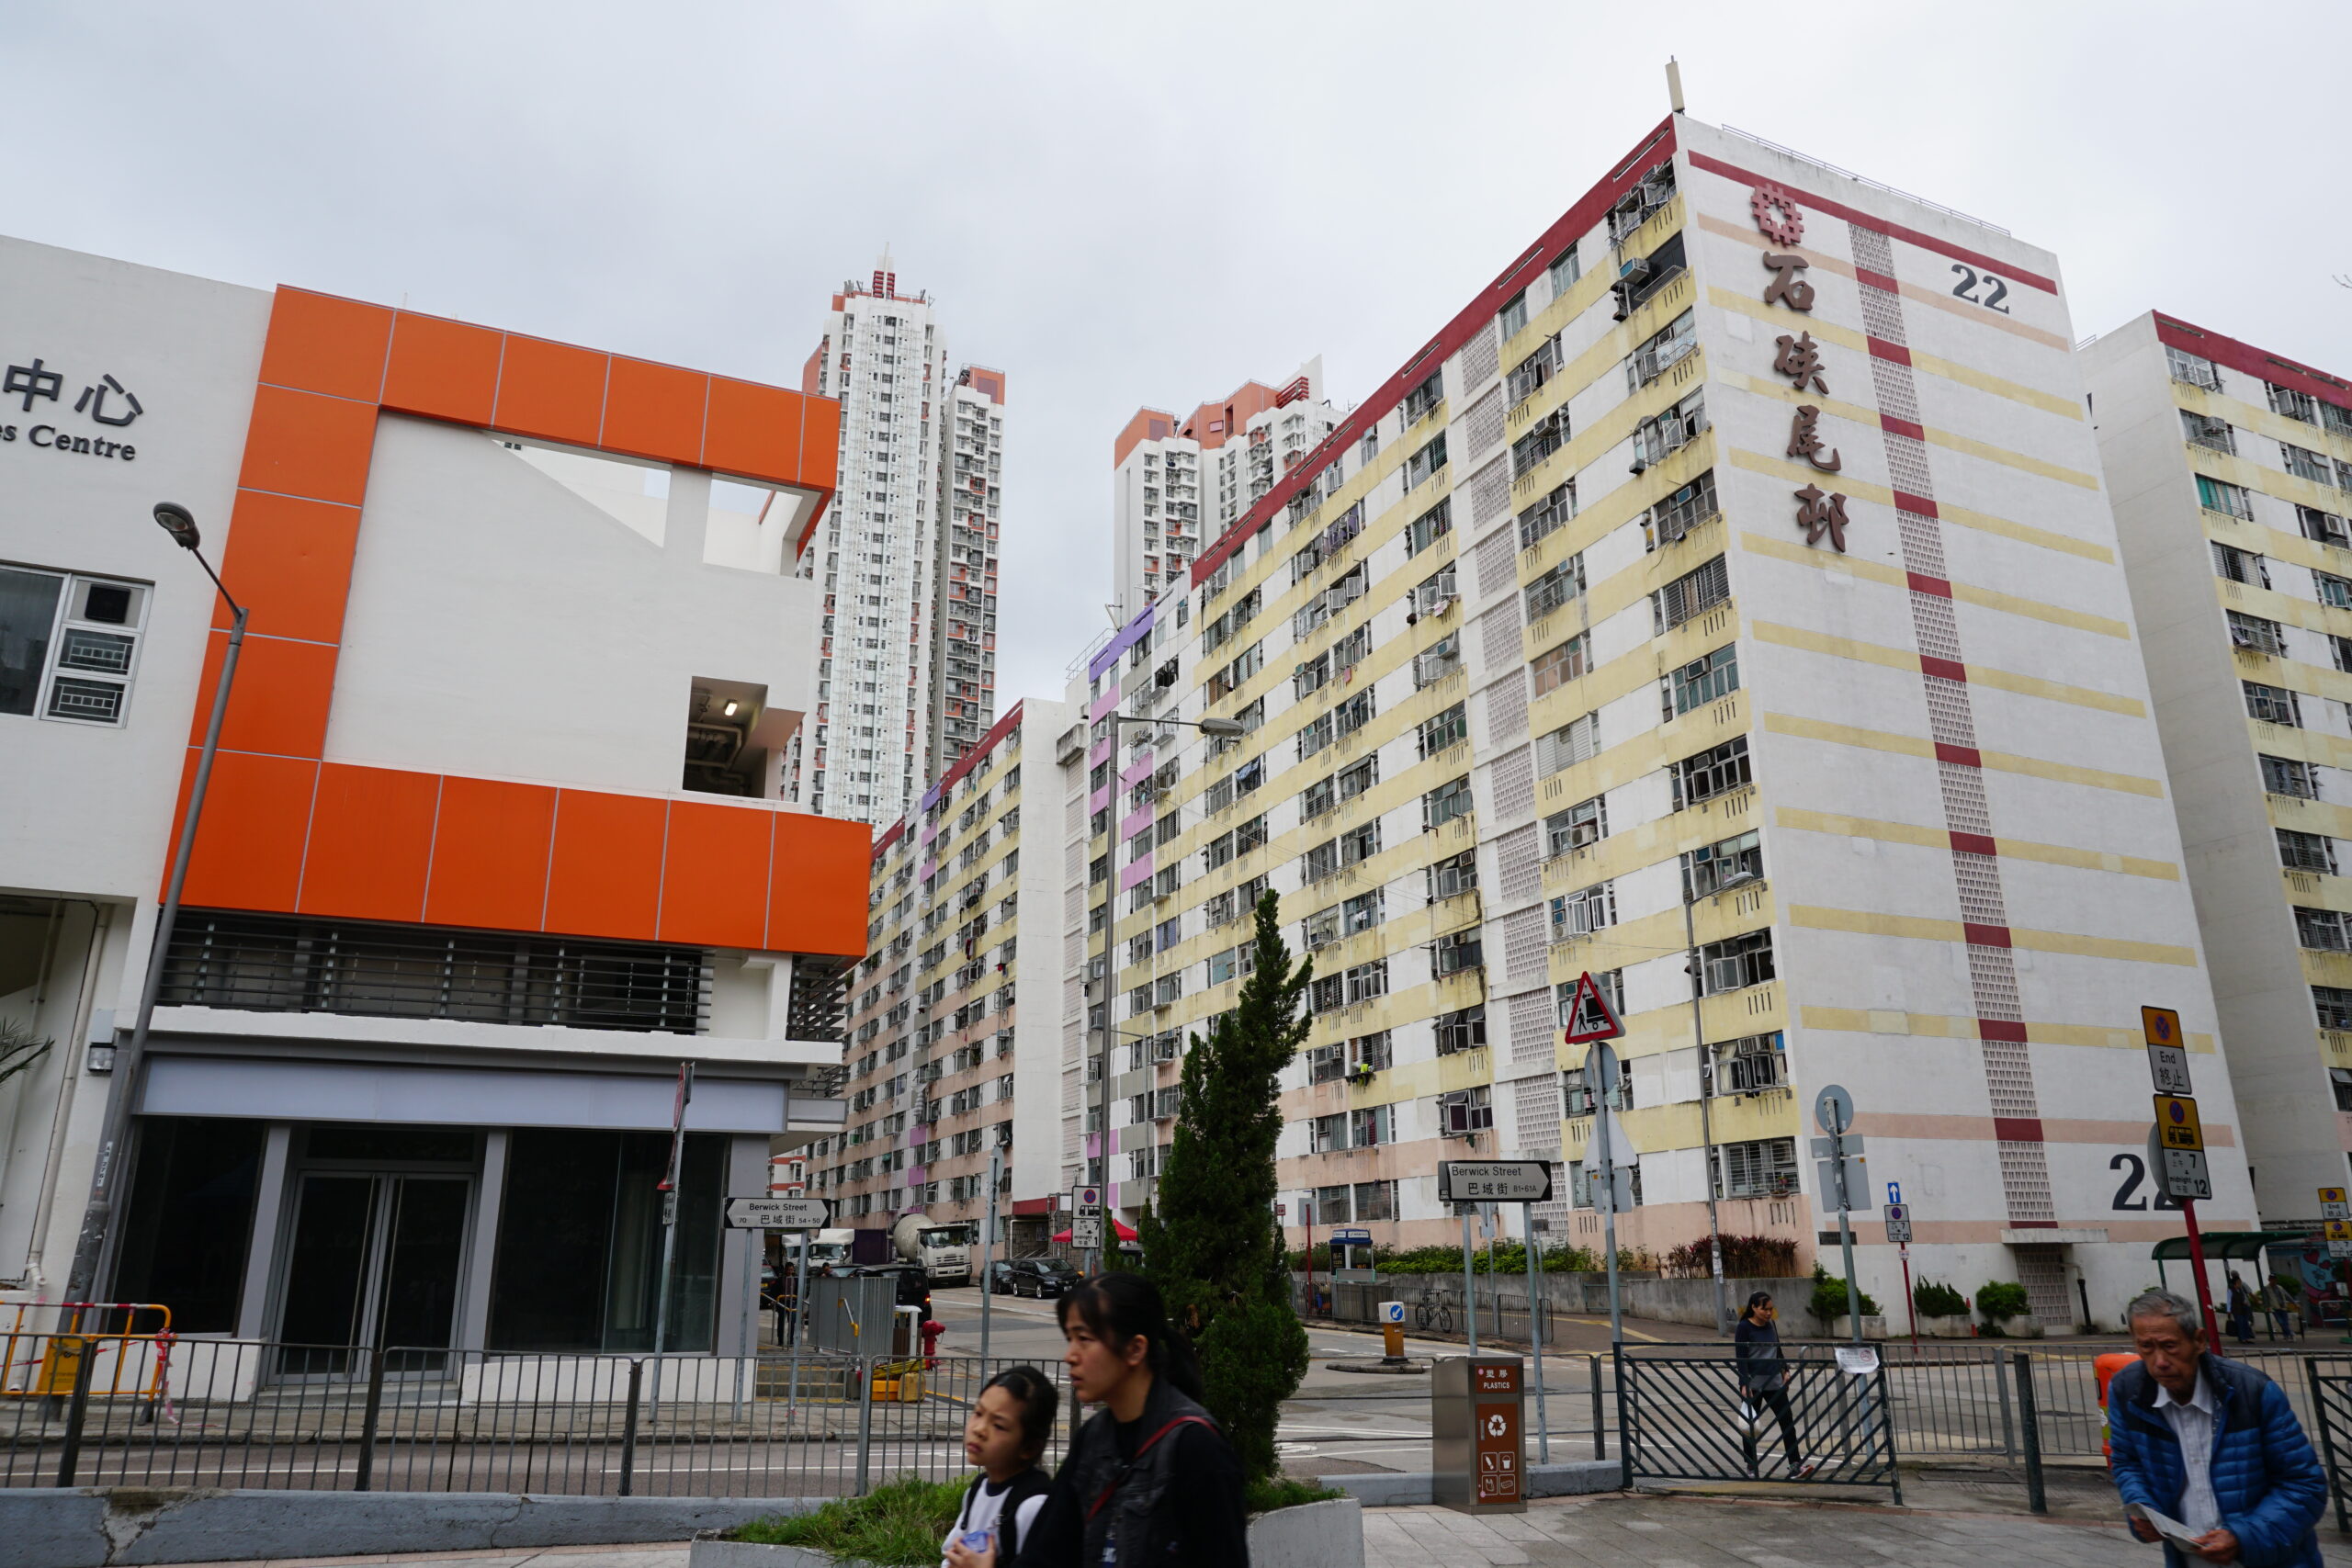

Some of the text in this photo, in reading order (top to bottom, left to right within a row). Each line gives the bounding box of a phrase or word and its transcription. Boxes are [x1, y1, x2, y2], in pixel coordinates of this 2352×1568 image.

[1951, 263, 2010, 315] 22
[3, 358, 143, 426] 中心
[28, 424, 136, 461] Centre
[2159, 1050, 2177, 1065] End
[2159, 1066, 2184, 1087] 終止
[2188, 1153, 2197, 1169] 7
[1451, 1166, 1521, 1177] Berwick Street
[1467, 1182, 1508, 1195] 巴域街
[2193, 1179, 2208, 1195] 12
[749, 1202, 808, 1212] Berwick Street
[760, 1214, 795, 1224] 巴域街
[1483, 1382, 1510, 1390] PLASTICS
